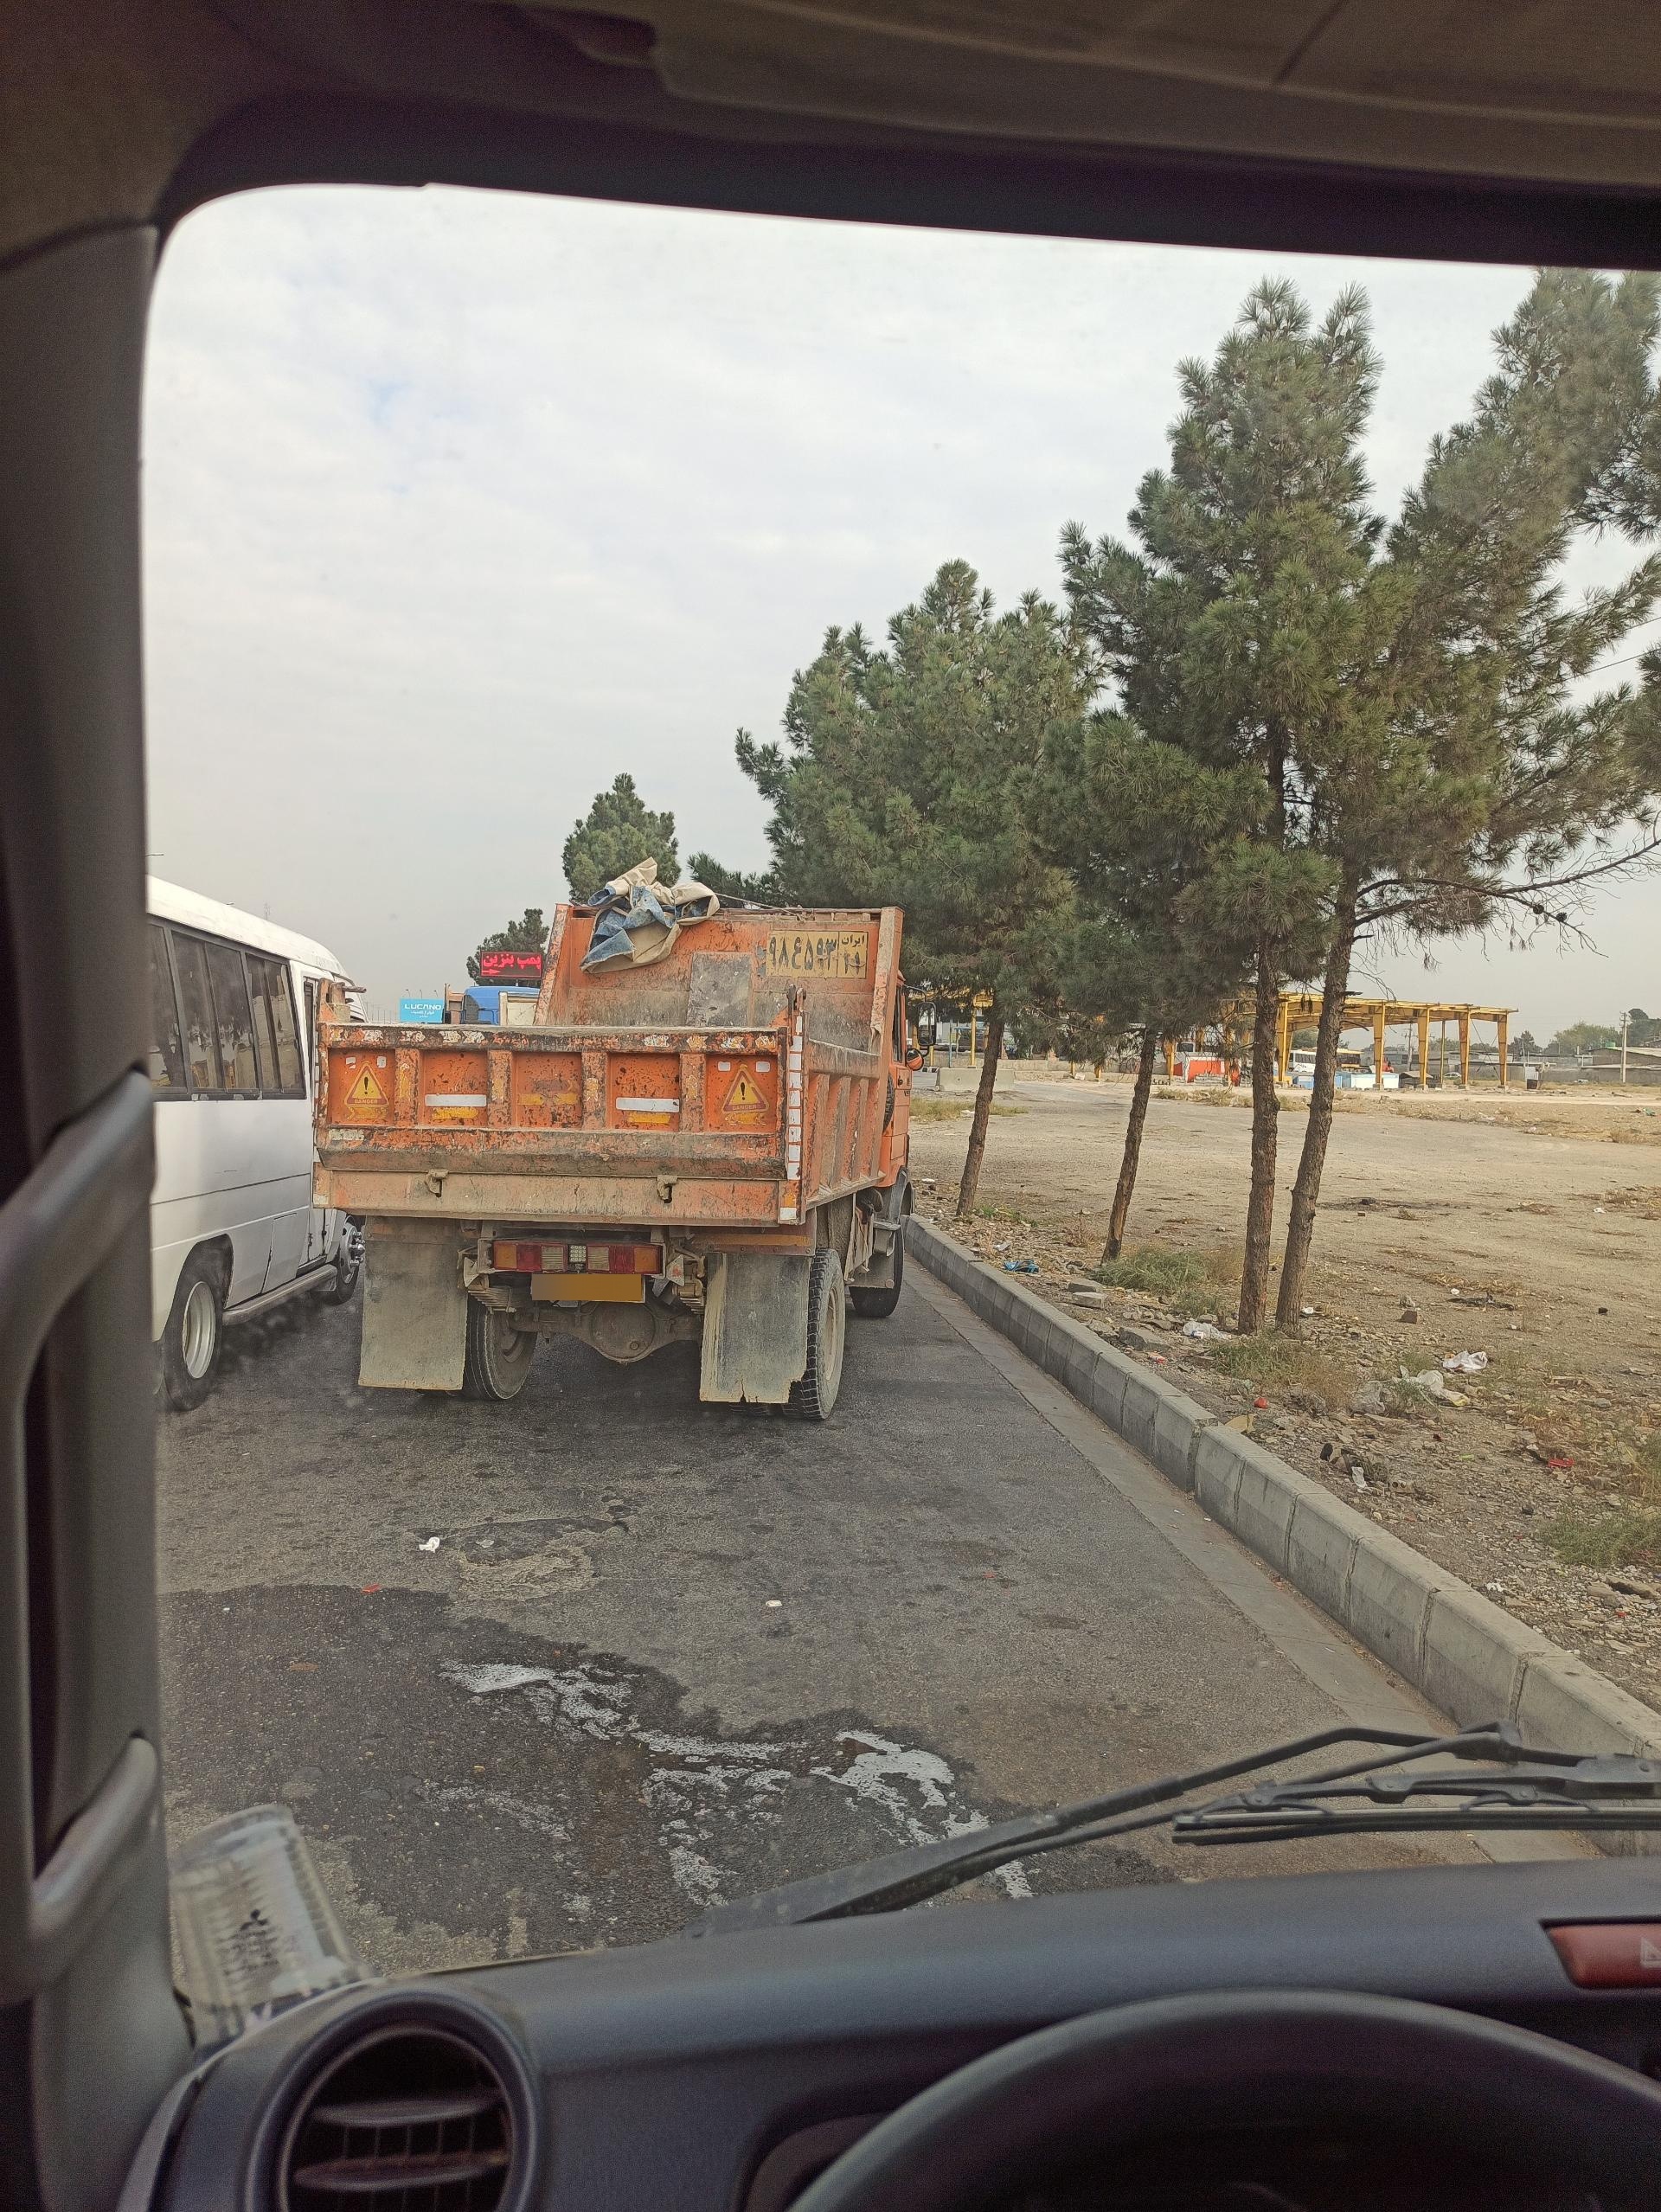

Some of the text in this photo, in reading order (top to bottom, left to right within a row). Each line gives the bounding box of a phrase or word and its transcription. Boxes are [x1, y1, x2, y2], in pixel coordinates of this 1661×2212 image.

[842, 934, 864, 947] ایران
[483, 952, 541, 970] پمپ بنزین
